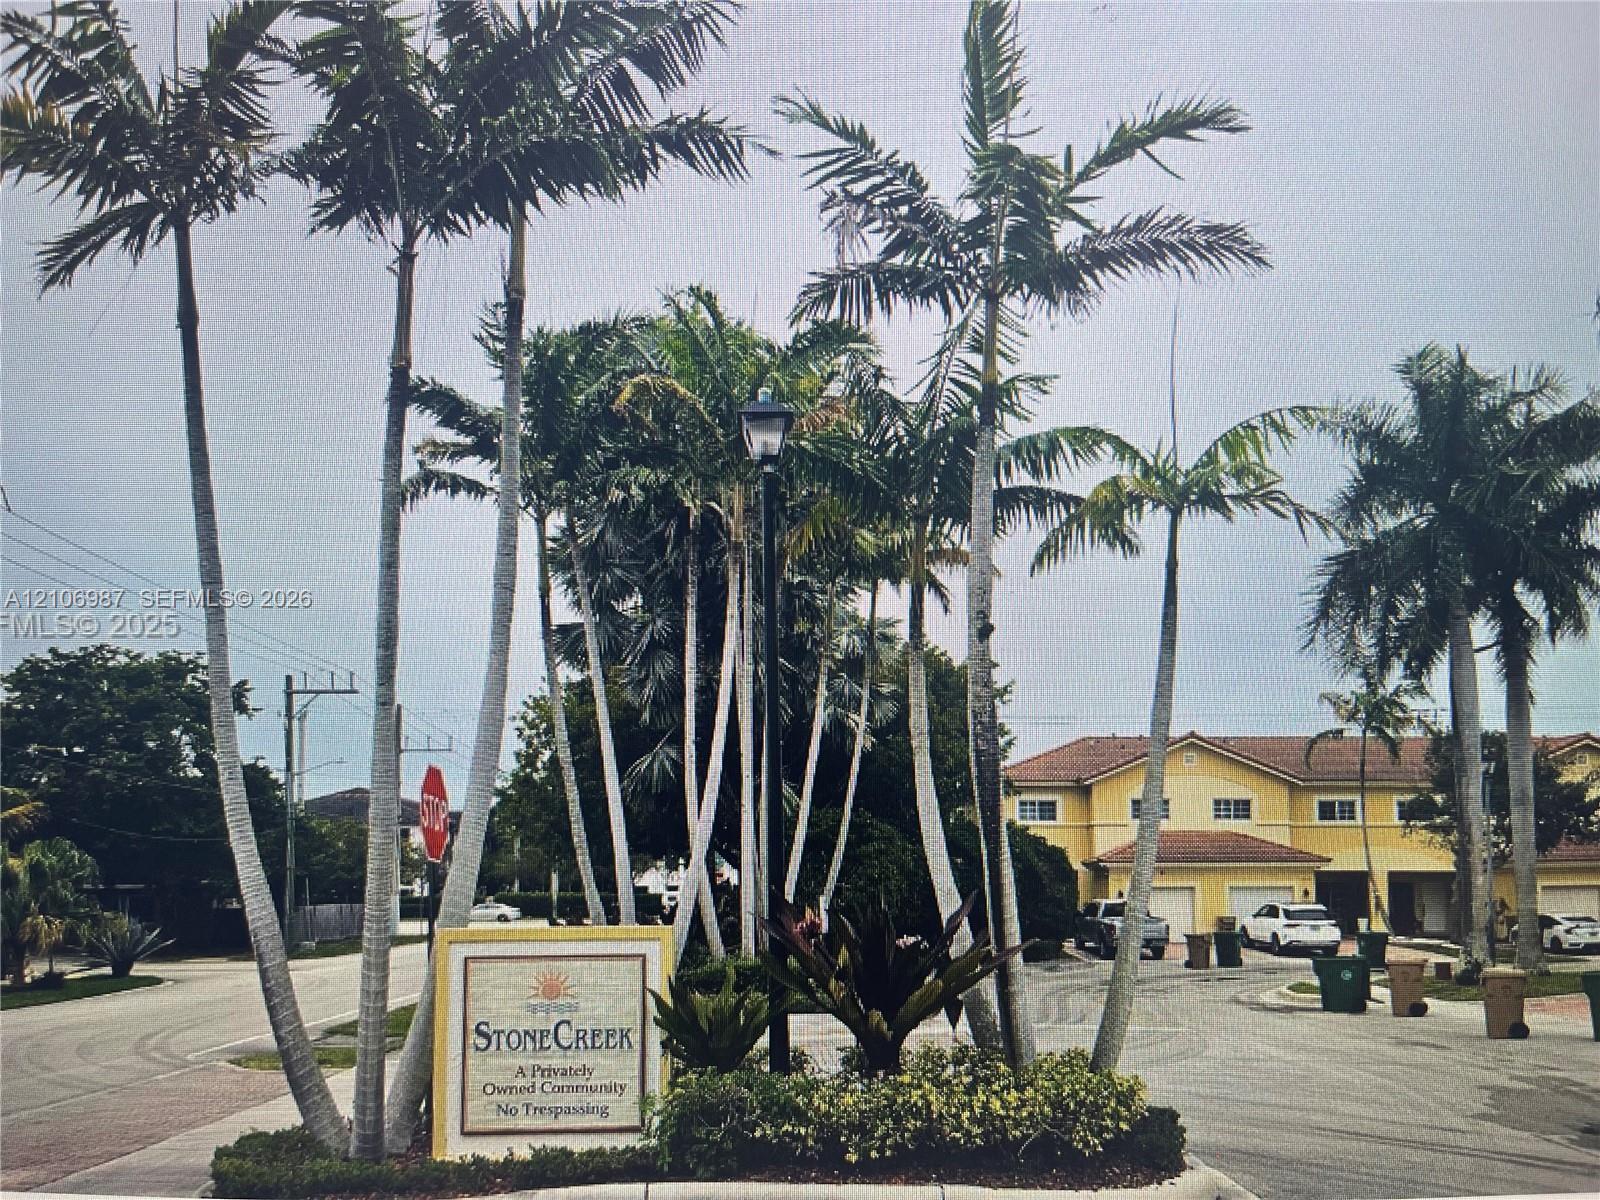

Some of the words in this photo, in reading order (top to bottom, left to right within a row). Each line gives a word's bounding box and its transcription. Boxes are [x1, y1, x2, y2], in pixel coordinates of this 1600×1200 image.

[423, 795, 447, 831] STOP
[514, 1065, 527, 1079] A
[531, 1063, 595, 1081] Privately
[482, 1081, 537, 1096] Owned
[540, 1081, 628, 1098] Community
[496, 1103, 519, 1117] No
[521, 1102, 610, 1119] Trespassing
